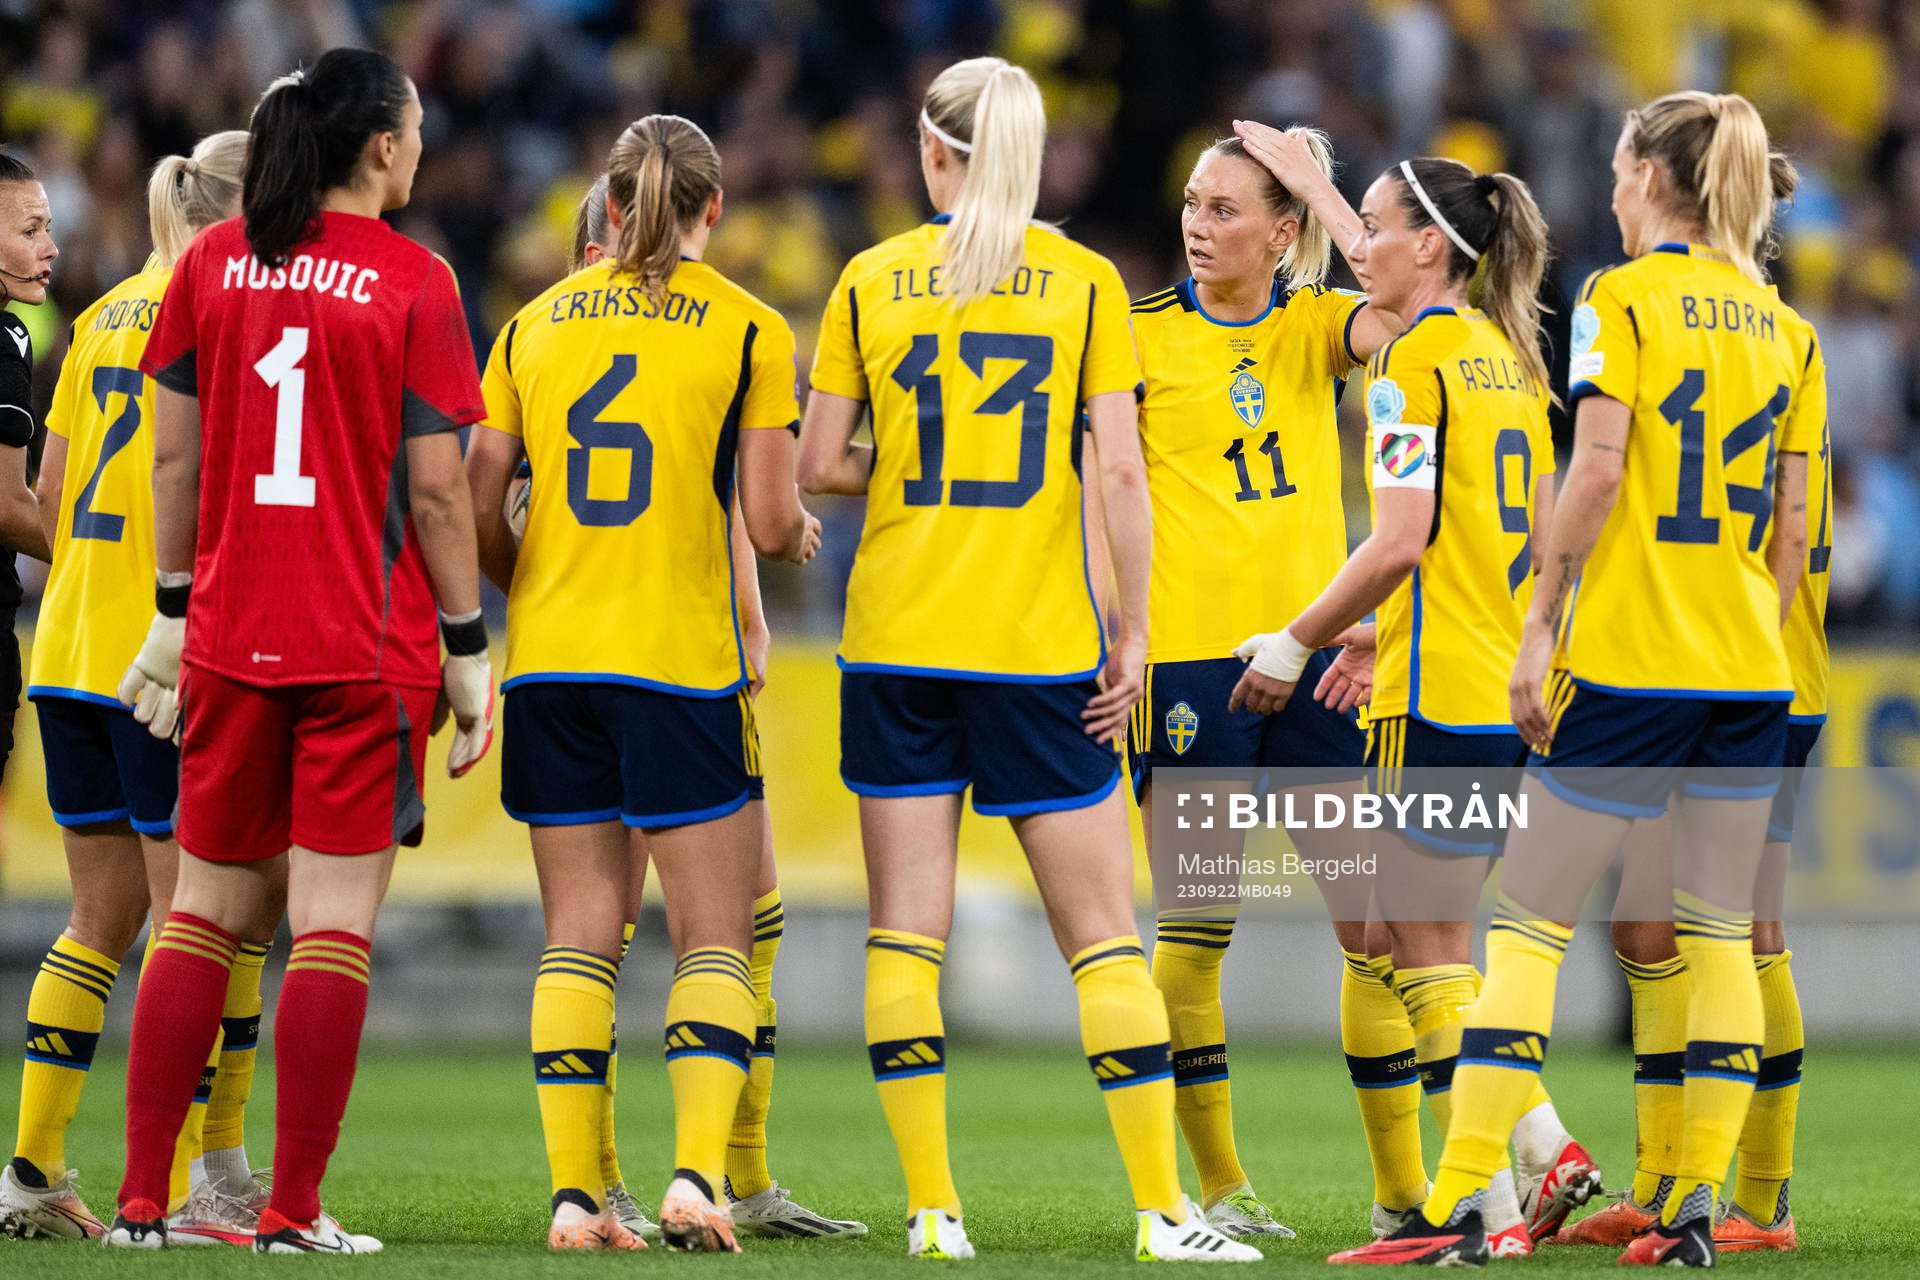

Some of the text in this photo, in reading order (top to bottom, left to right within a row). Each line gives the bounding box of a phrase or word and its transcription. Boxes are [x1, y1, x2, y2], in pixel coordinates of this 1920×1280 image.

[892, 266, 1054, 301] ILEDT
[1681, 294, 1776, 342] BJÖRN
[72, 366, 143, 542] 2
[253, 326, 316, 507] 1
[567, 354, 653, 527] 6
[890, 331, 1054, 508] 13
[1223, 431, 1297, 502] 11
[1656, 369, 1790, 553] 14
[1494, 428, 1532, 600] 9
